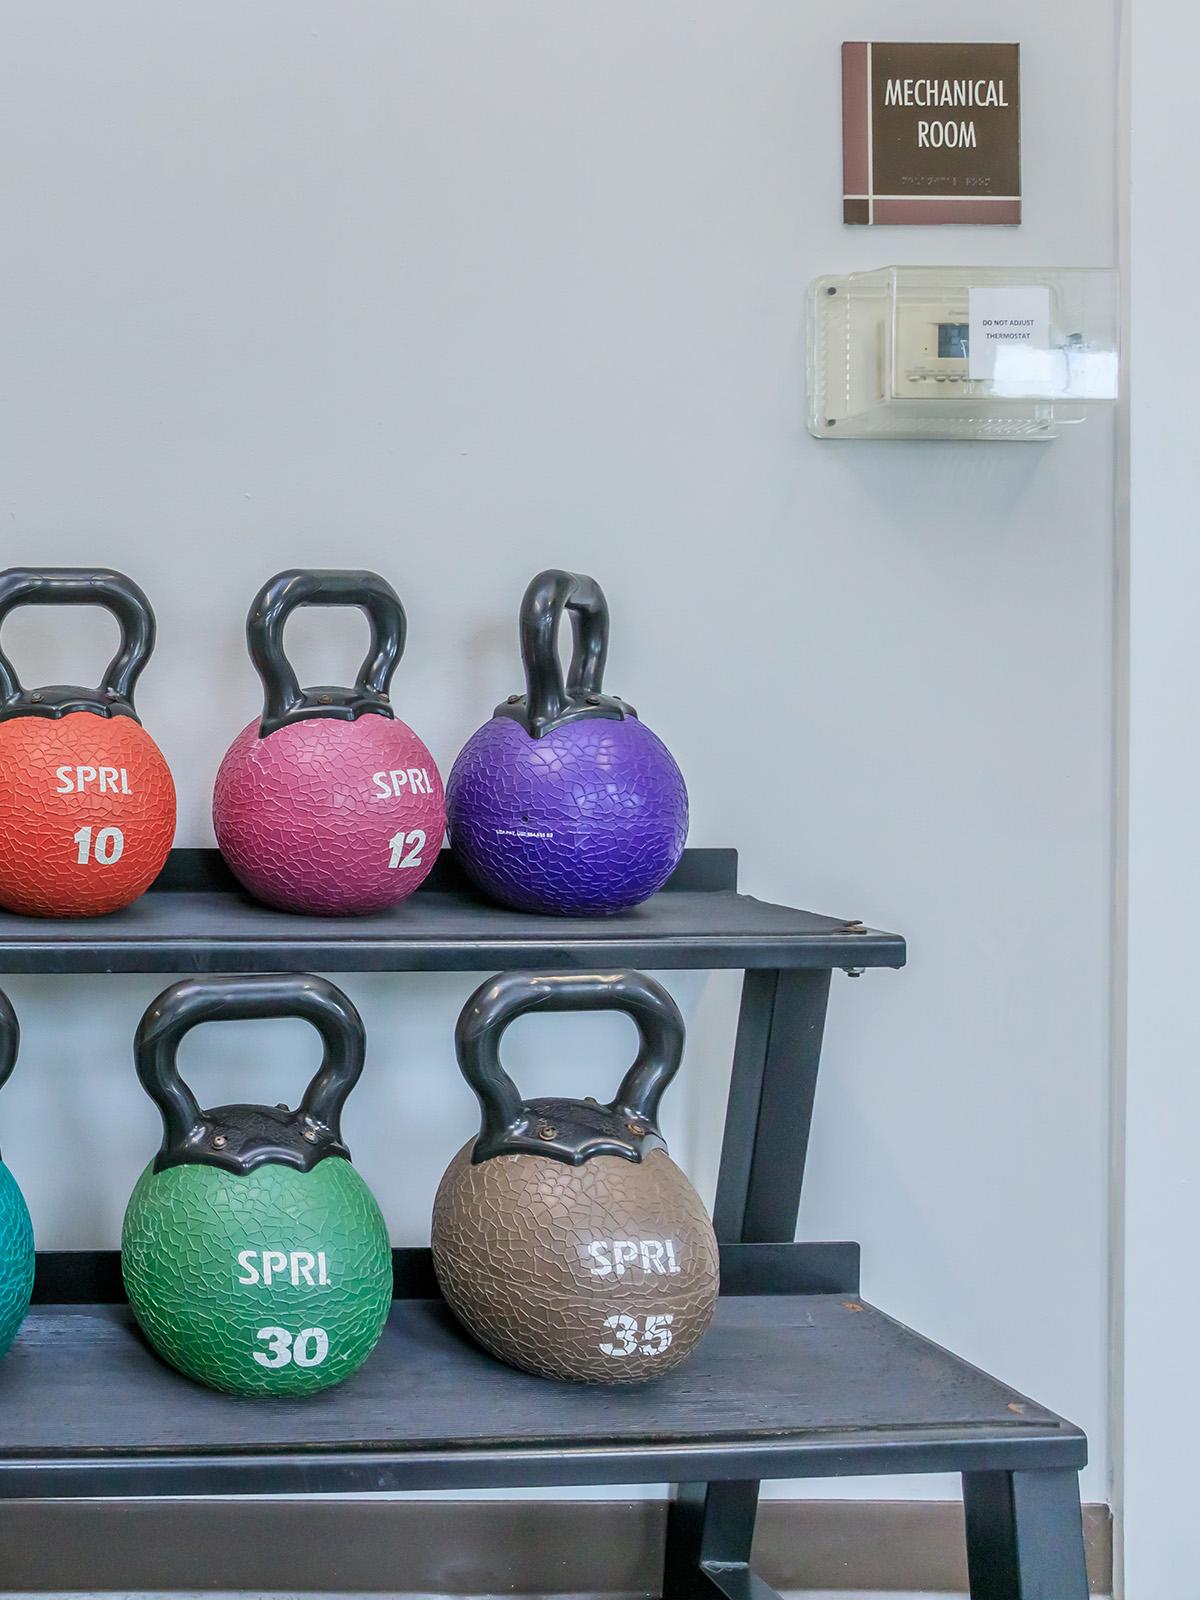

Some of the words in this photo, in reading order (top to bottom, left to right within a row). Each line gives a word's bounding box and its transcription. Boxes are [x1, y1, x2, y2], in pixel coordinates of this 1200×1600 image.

[885, 79, 1009, 107] MECHANICAL
[918, 121, 977, 148] ROOM
[986, 332, 1031, 340] THERMOSTAT
[56, 765, 132, 796] SPRI
[372, 768, 434, 799] SPRI
[74, 826, 124, 865] 10
[388, 830, 427, 868] 12
[237, 1250, 331, 1286] SPRI
[587, 1240, 680, 1275] SPRI
[252, 1326, 329, 1368] 30
[598, 1316, 674, 1357] 35
